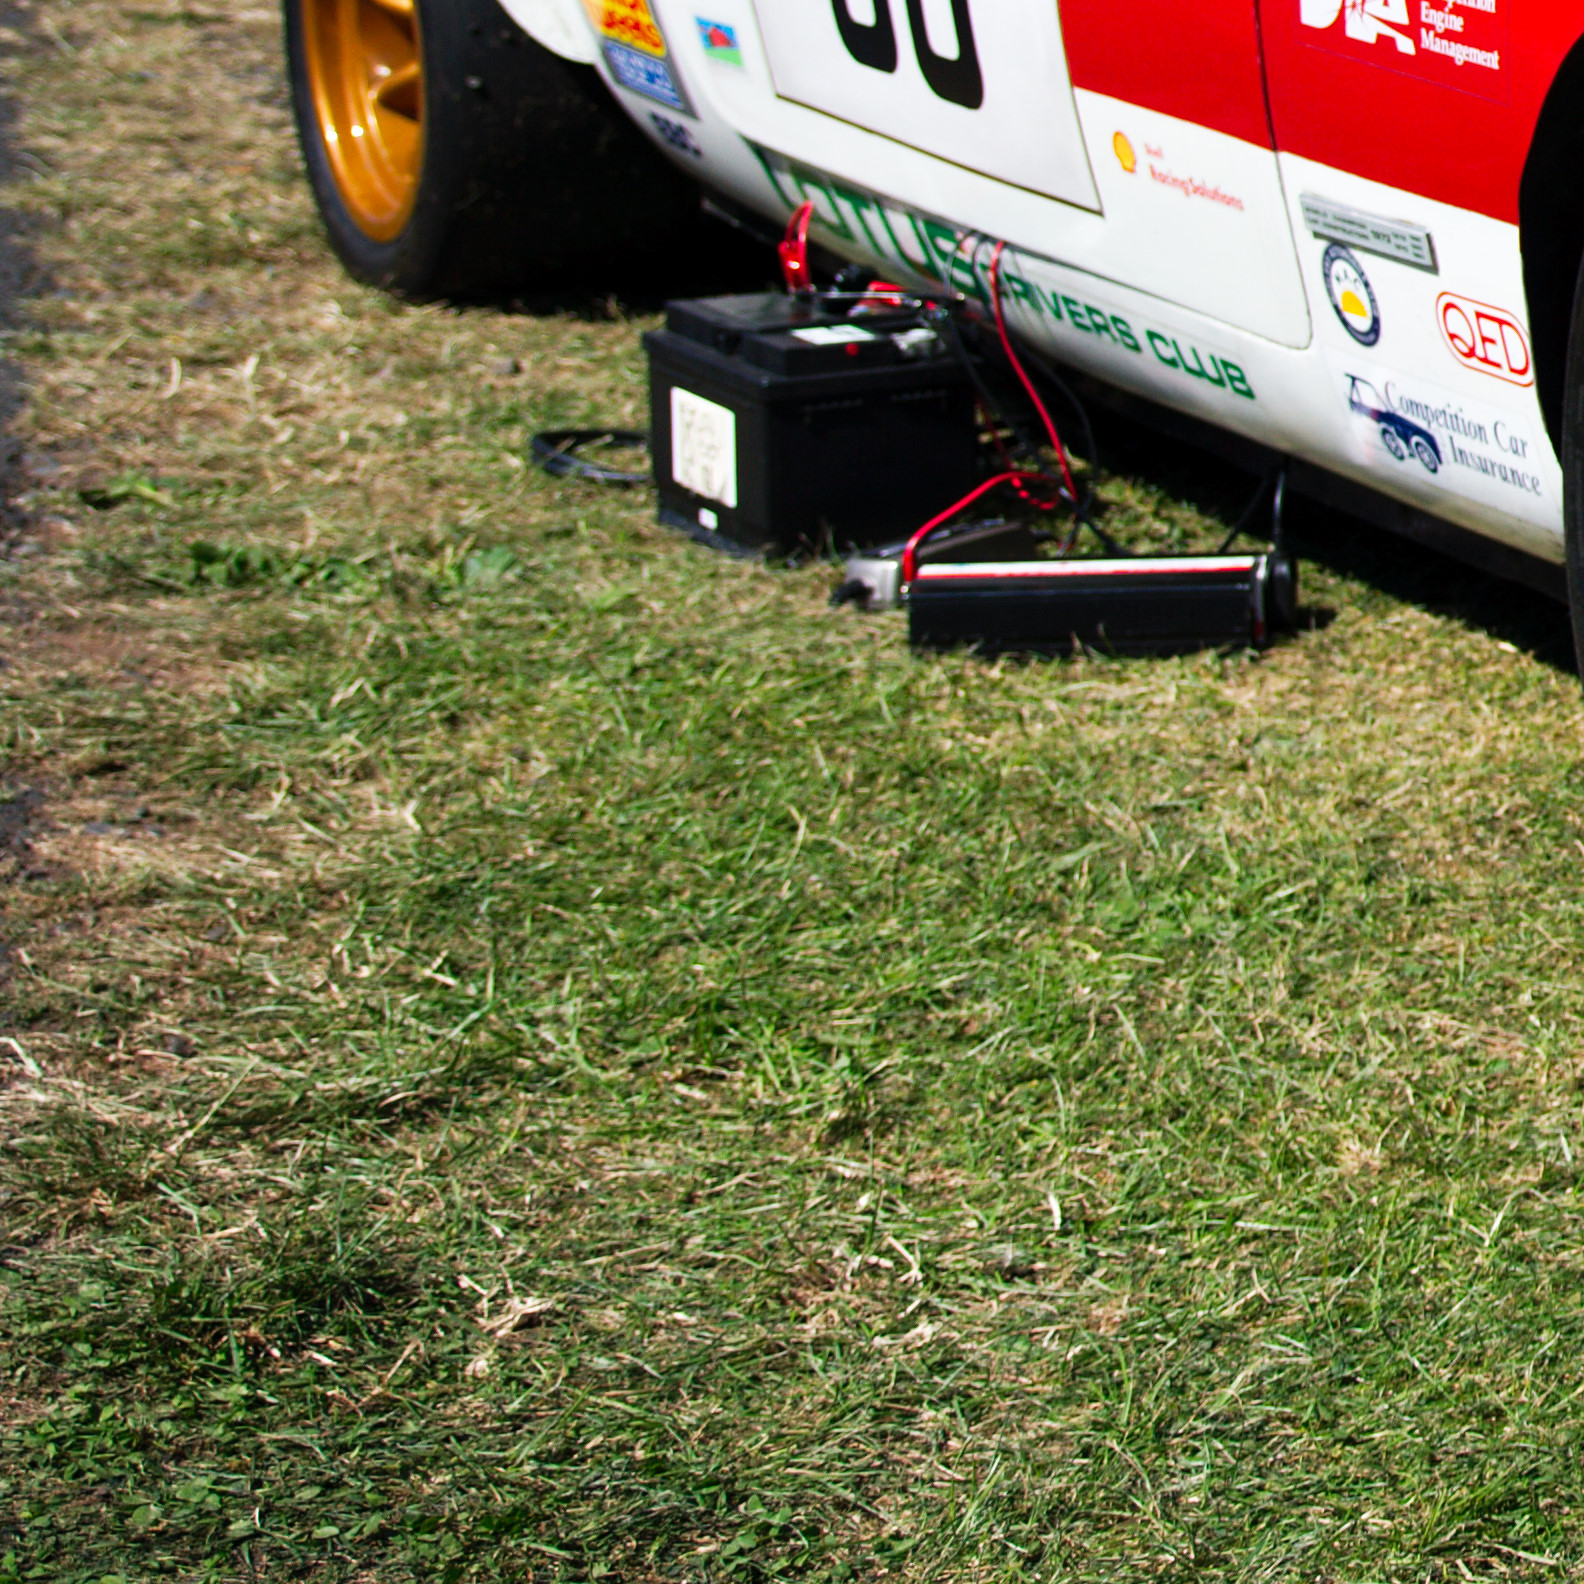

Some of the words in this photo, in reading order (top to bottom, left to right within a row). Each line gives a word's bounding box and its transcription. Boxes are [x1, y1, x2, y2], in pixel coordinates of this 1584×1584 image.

[1420, 0, 1464, 33] Engine
[1420, 27, 1500, 71] Management
[1144, 328, 1256, 400] CLUB
[1442, 301, 1530, 376] QED
[1385, 380, 1489, 445] Competition
[1492, 420, 1529, 459] Car
[1448, 434, 1543, 497] Insurance
